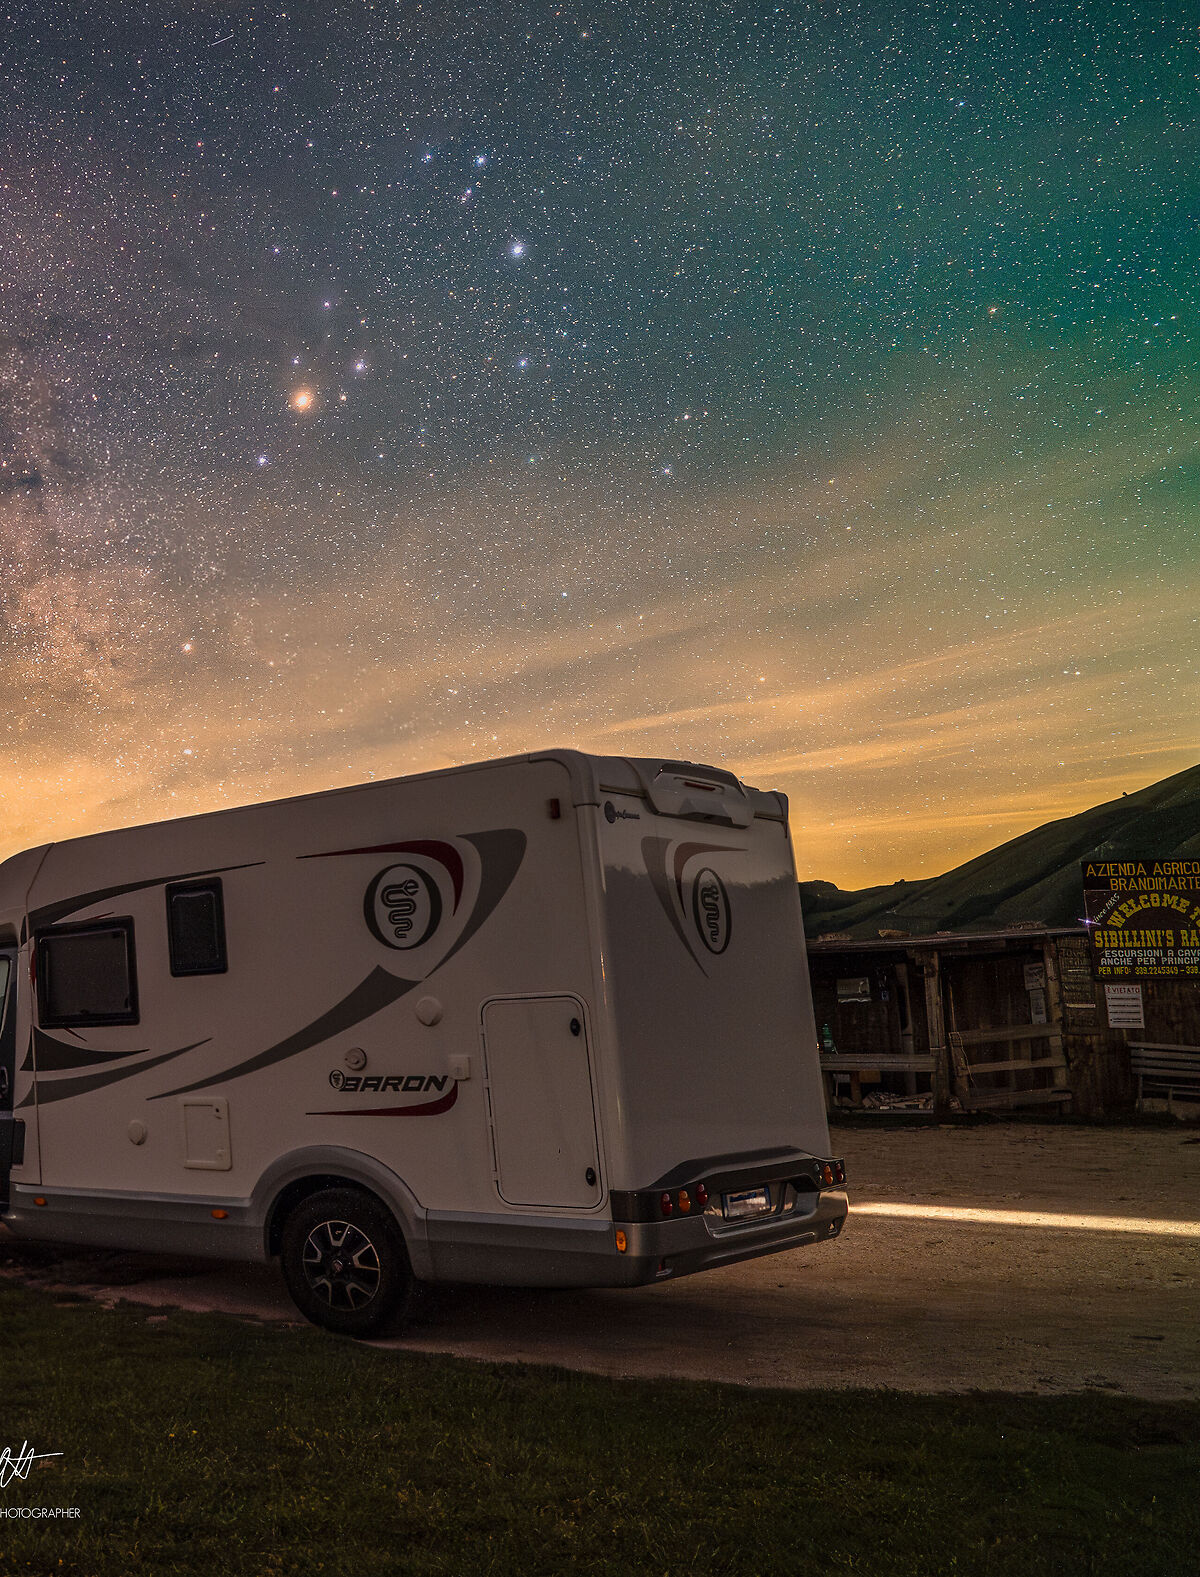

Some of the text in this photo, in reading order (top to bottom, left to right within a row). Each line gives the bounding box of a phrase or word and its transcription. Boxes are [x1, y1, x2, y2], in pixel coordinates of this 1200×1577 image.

[1086, 862, 1200, 877] AZIENDA AGRICO
[1110, 877, 1200, 891] BRANDIMARTE
[1106, 893, 1191, 928] WELCOME
[1094, 930, 1174, 948] SIBILLINI'S
[1105, 949, 1163, 958] ESCURSIONI
[1167, 949, 1174, 957] A
[1100, 957, 1200, 966] ANCHE PER PRINCIP
[1098, 966, 1112, 975] PER
[1114, 966, 1132, 975] INFO:
[338, 1075, 449, 1092] BARON
